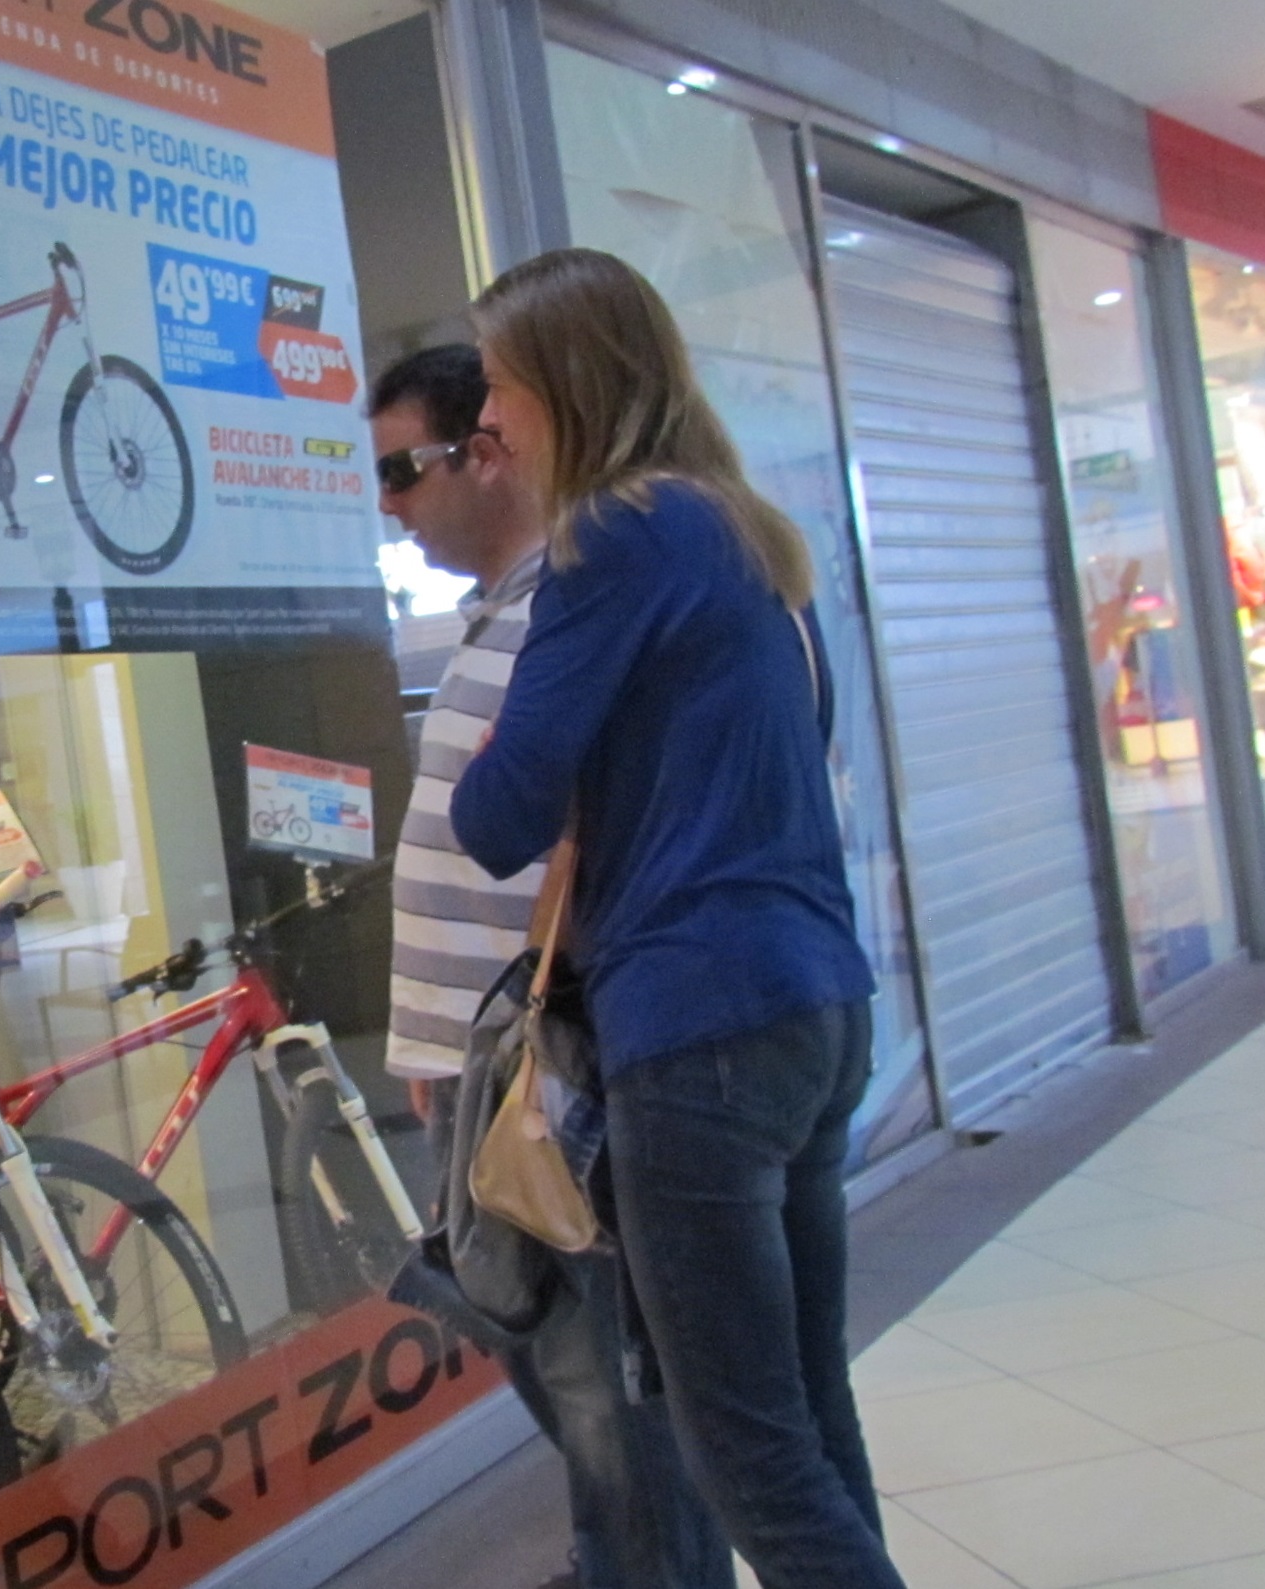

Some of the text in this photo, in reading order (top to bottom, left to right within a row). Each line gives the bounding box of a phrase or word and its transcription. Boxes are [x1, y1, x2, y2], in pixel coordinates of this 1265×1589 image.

[75, 41, 102, 67] DE
[114, 54, 219, 105] DEPORTES
[84, 0, 267, 87] ZONE
[10, 86, 87, 140] DEJES
[93, 111, 127, 153] DE
[131, 124, 250, 187] PEDALEAR
[128, 168, 257, 246] PRECIO
[208, 426, 294, 458] BICICLETA
[213, 460, 311, 491] AVALANCHE
[314, 468, 337, 493] 2.0
